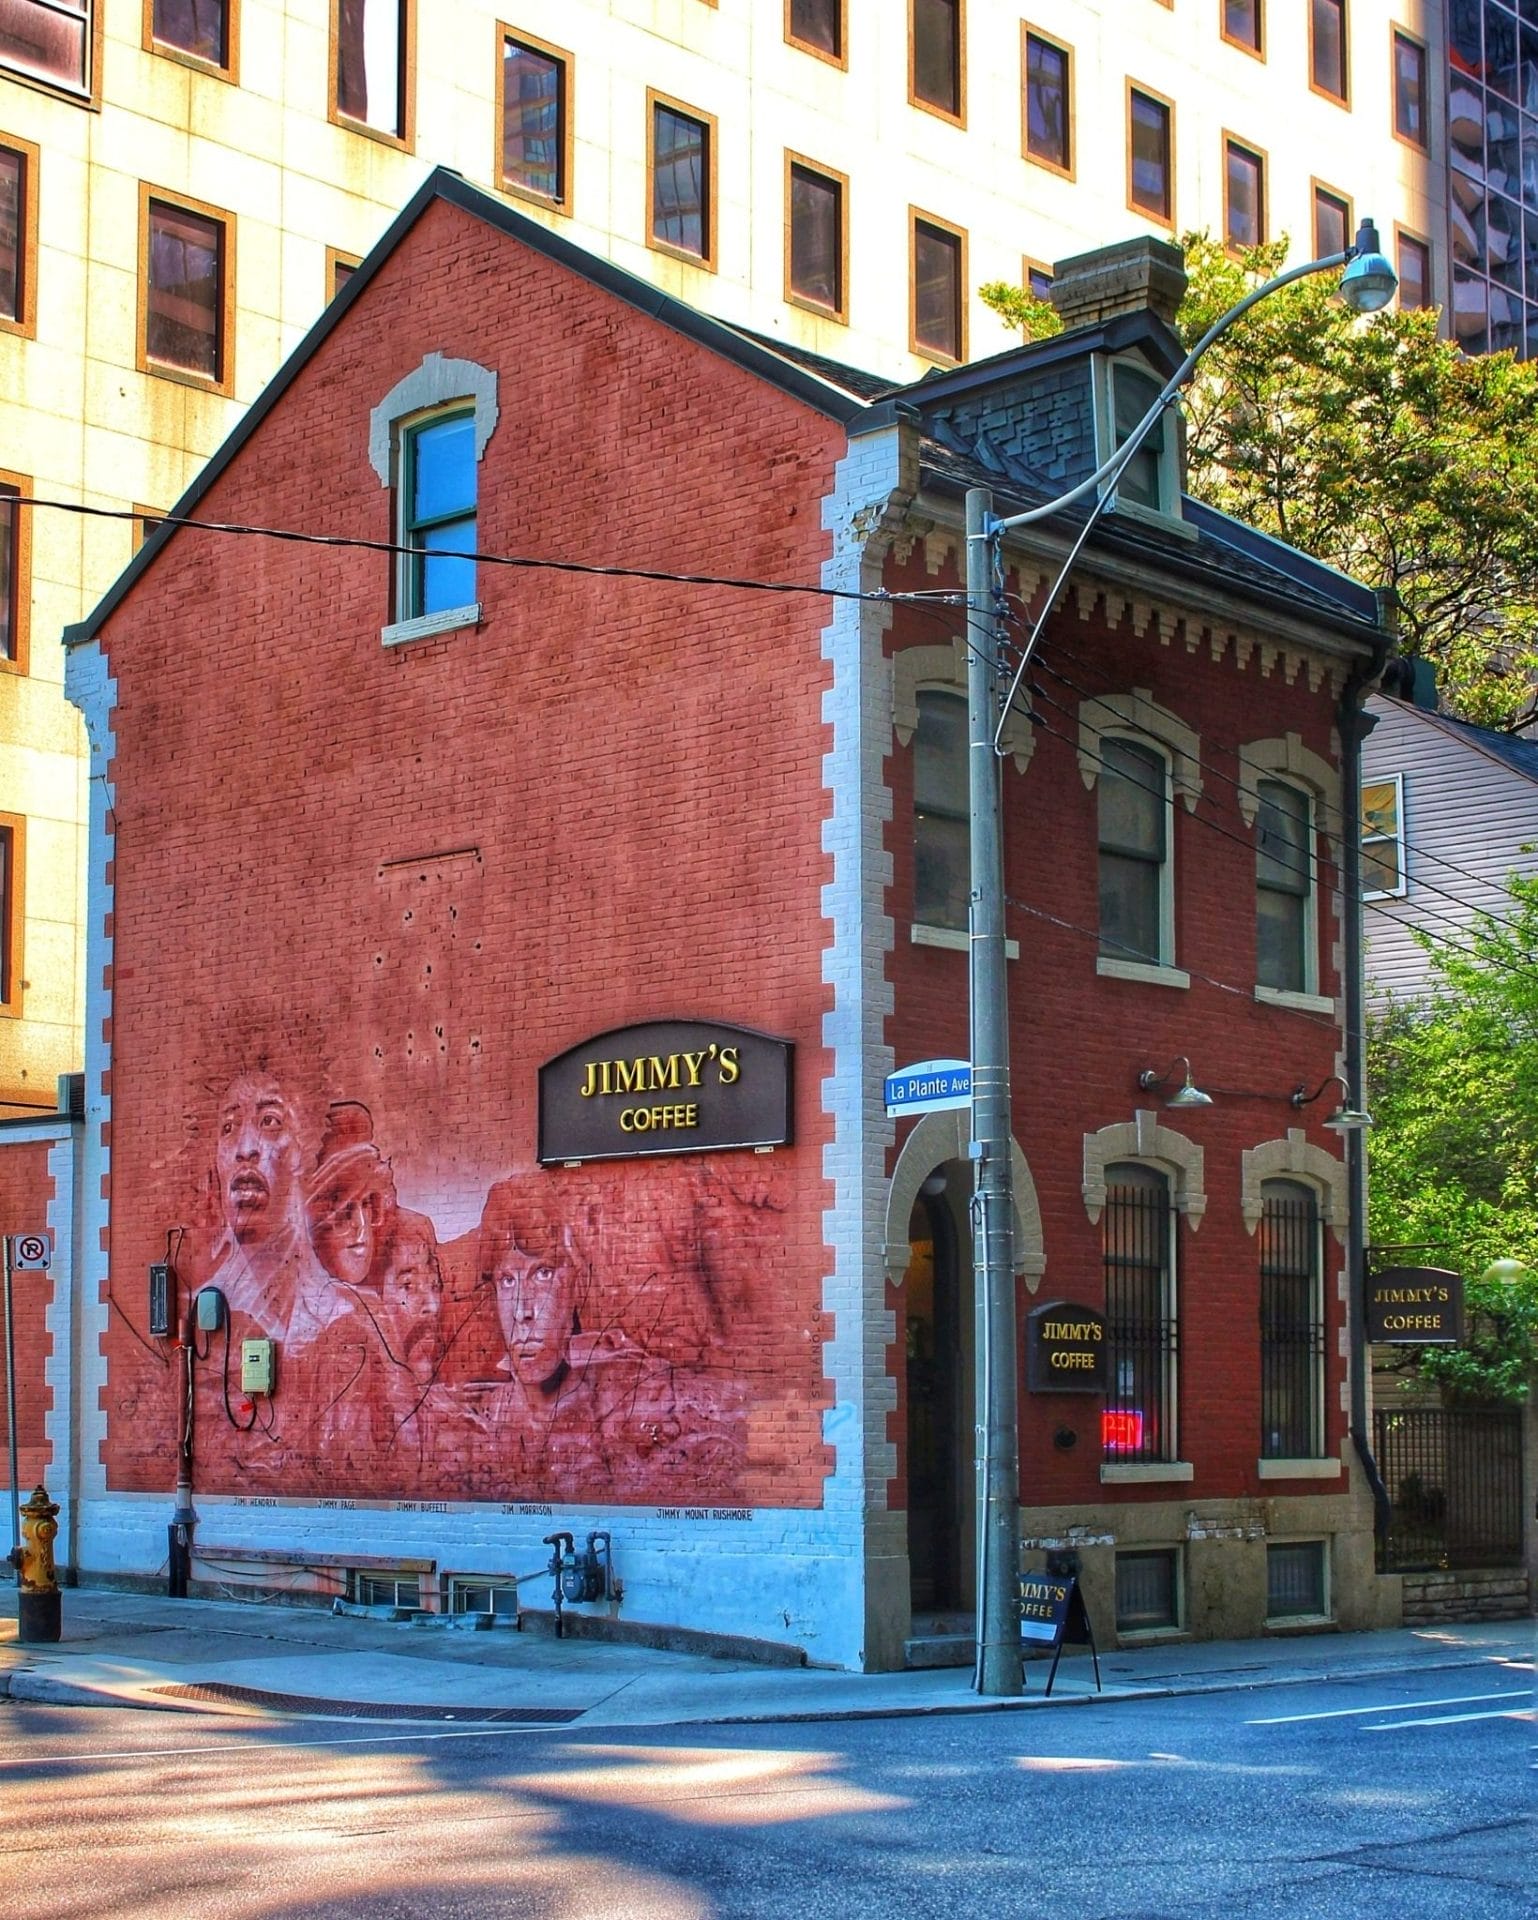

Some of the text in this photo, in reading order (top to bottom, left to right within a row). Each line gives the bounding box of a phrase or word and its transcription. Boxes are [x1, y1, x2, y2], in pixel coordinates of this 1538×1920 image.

[580, 1043, 741, 1098] JIMMY'S
[891, 1077, 970, 1100] La Plante Ave
[619, 1103, 699, 1132] COFFEE
[1373, 1285, 1449, 1303] JIMMY'S
[1042, 1321, 1102, 1341] JIMMY'S
[1383, 1314, 1442, 1330] COFFEE
[1051, 1351, 1095, 1369] COFFEE
[1102, 1415, 1138, 1446] PEN
[317, 1499, 356, 1511] JIMMY PAGE
[396, 1502, 416, 1512] JIMMY
[501, 1504, 553, 1516] JIM MORRISON
[656, 1508, 753, 1522] JIMMY MOUNT RUSHMORE
[1020, 1582, 1066, 1601] MMY'S
[1020, 1603, 1053, 1617] OFFEE
